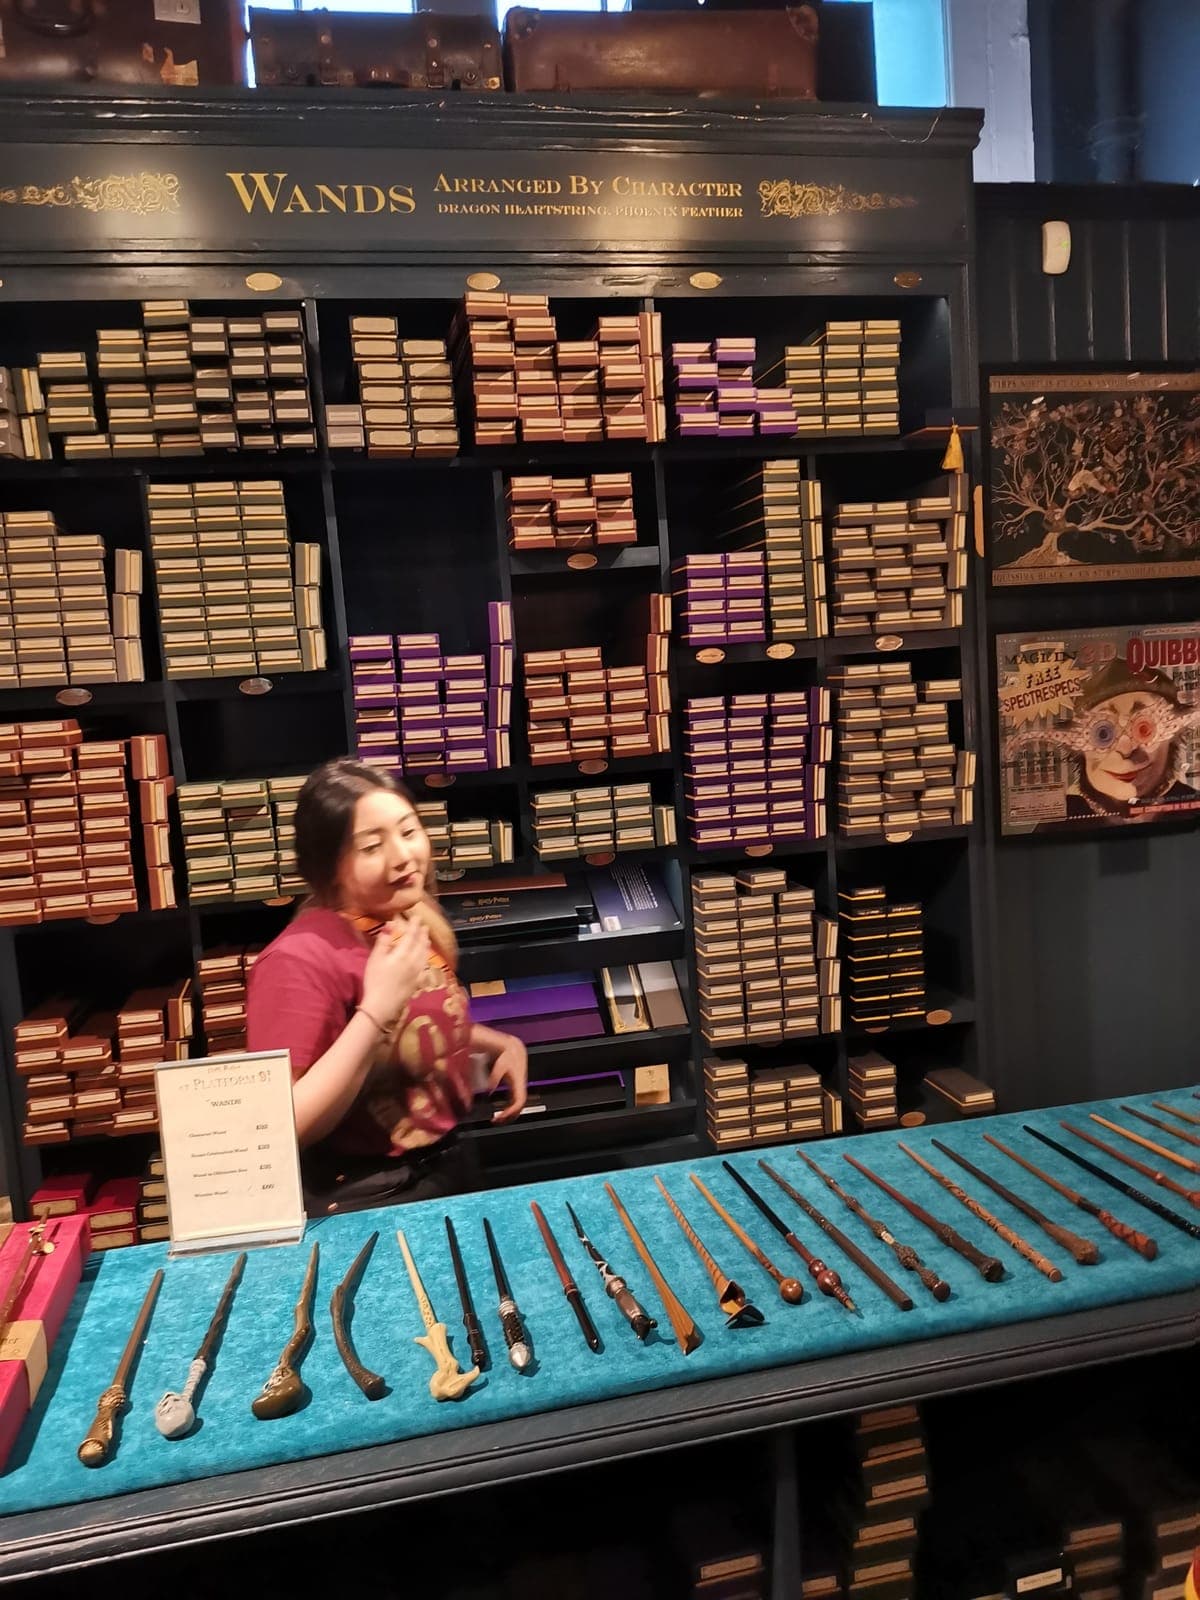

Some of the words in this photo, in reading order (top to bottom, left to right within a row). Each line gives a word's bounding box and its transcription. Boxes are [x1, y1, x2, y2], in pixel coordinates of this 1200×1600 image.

[225, 172, 416, 214] WANDS
[433, 173, 562, 194] ARRANGED
[569, 175, 604, 195] BY
[612, 176, 743, 197] CHARACTER
[438, 203, 500, 214] DRAGON
[616, 206, 678, 217] PHOENIX
[681, 206, 743, 217] FEATHER
[1026, 666, 1061, 689] FREE
[1003, 677, 1082, 712] SPECTRESPECS
